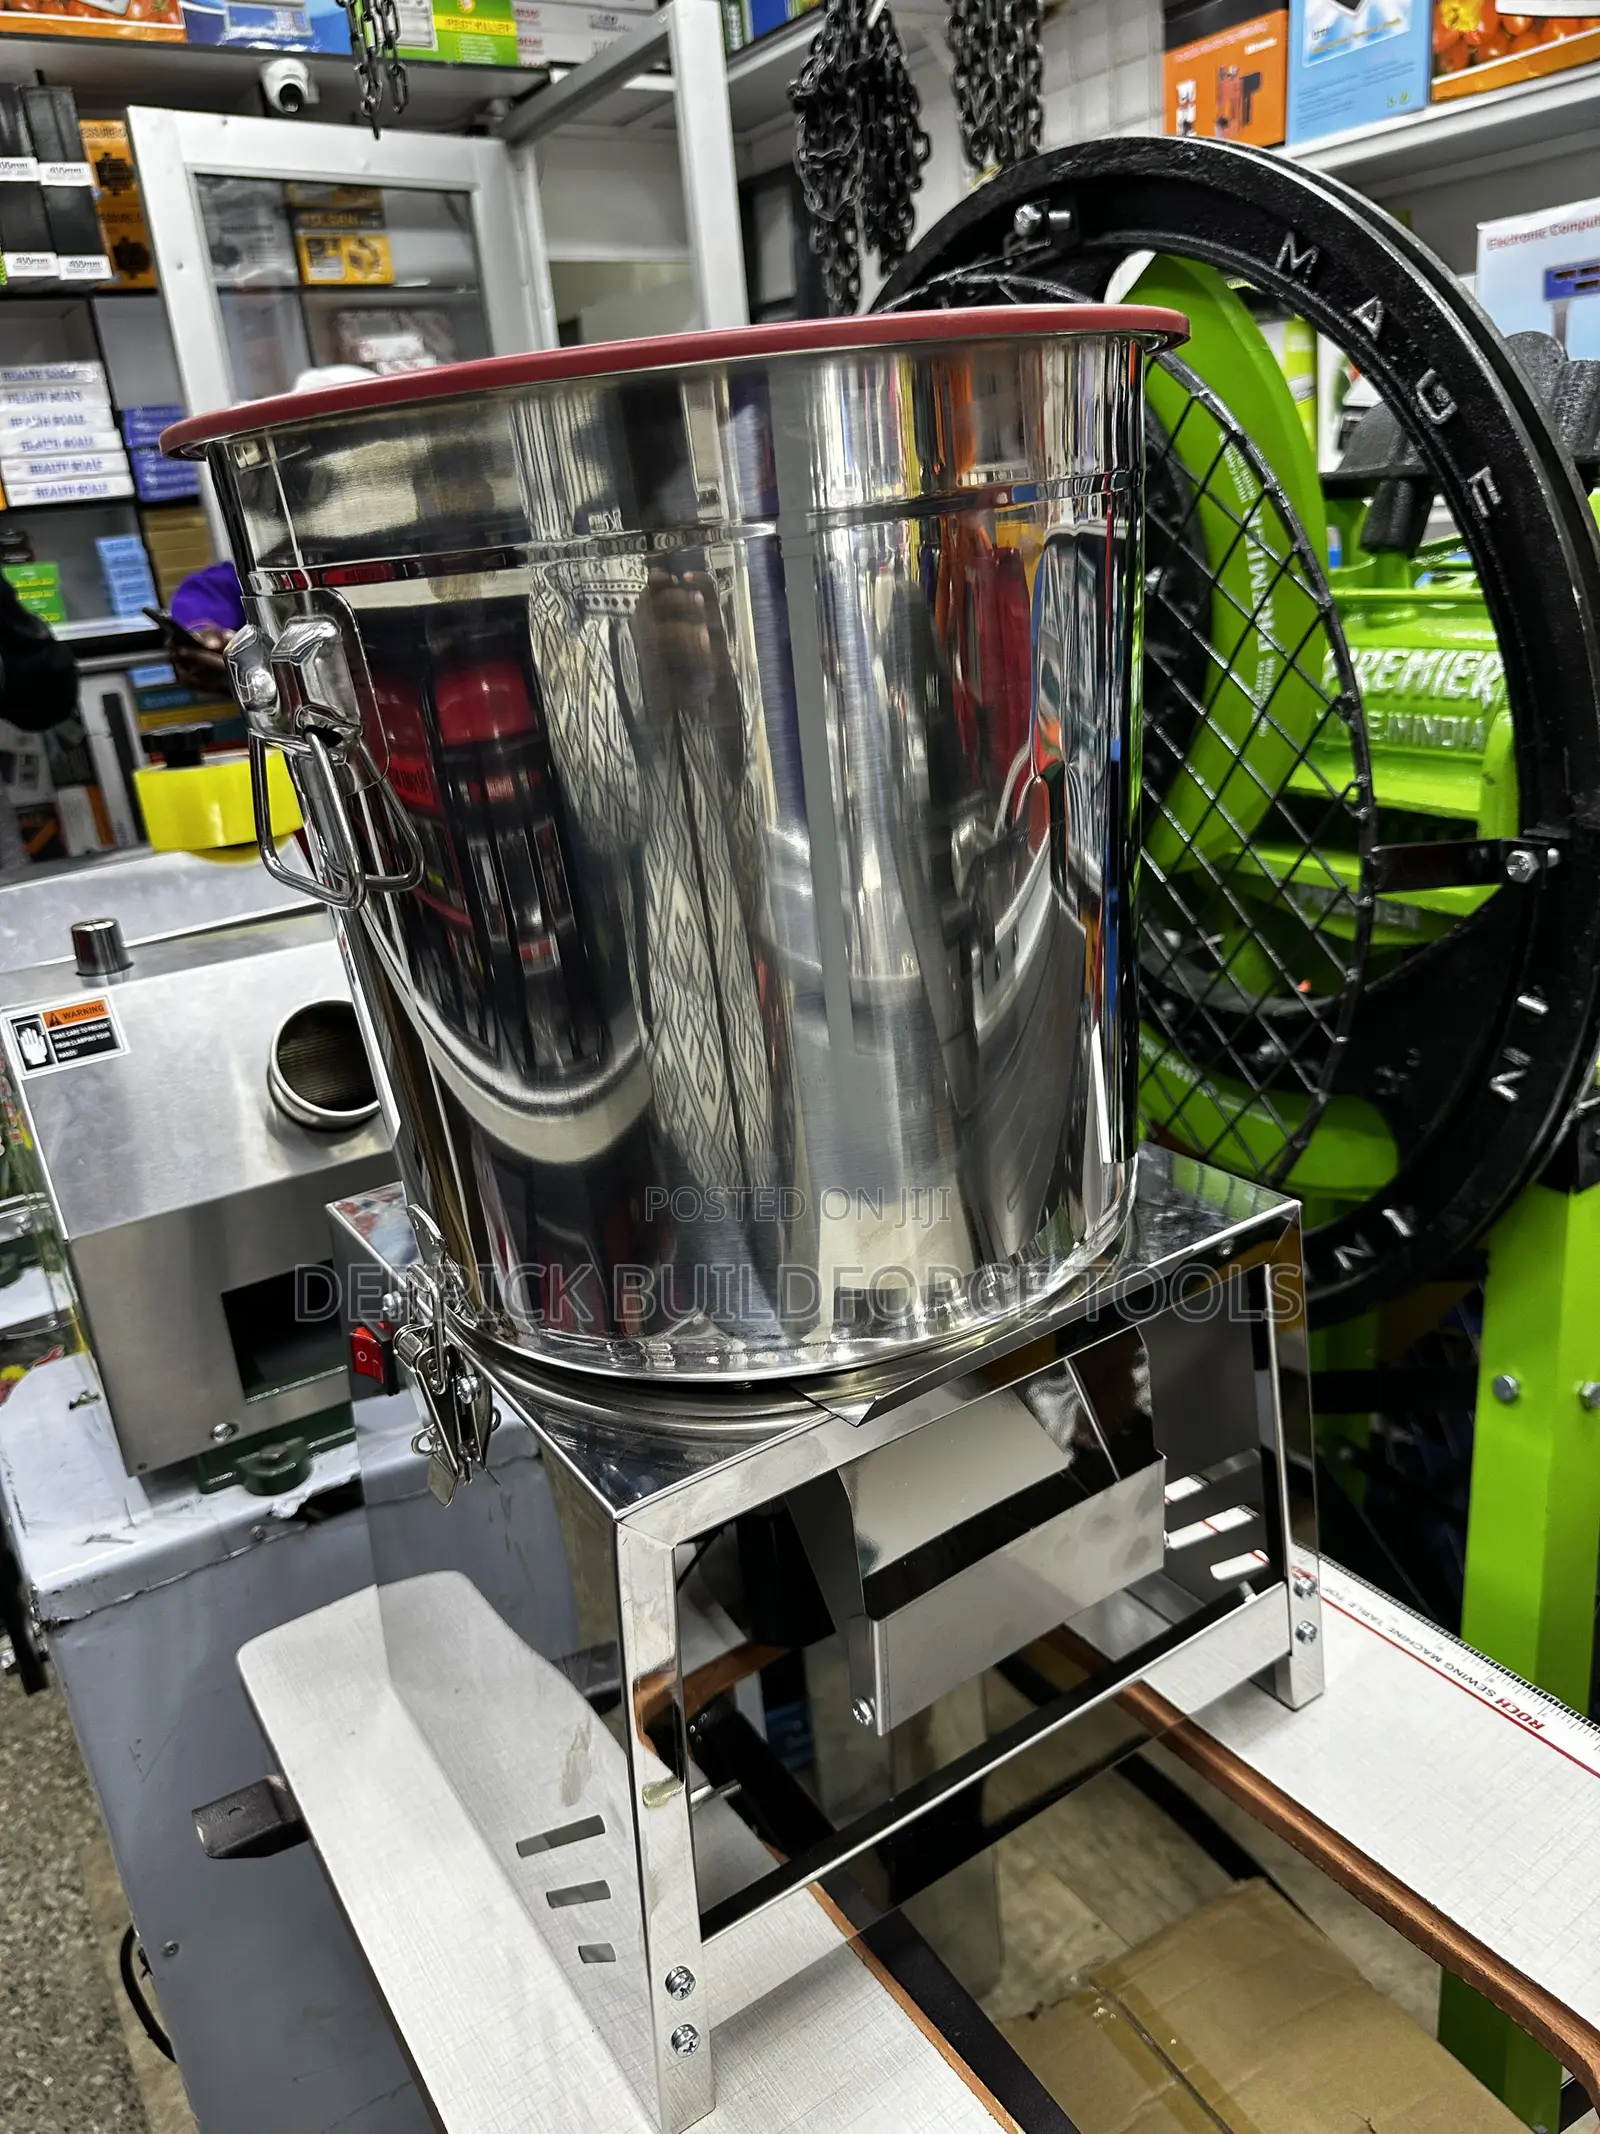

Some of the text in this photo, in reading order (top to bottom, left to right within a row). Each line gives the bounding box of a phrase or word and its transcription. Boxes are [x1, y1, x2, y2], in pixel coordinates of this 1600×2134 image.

[1319, 648, 1506, 710] PREMIER
[63, 1005, 105, 1019] WARNING
[1348, 1602, 1385, 1626] TABLE
[1388, 1627, 1443, 1663] MACHINE
[1443, 1662, 1497, 1698] SEWING
[1494, 1697, 1546, 1730] ROCH
